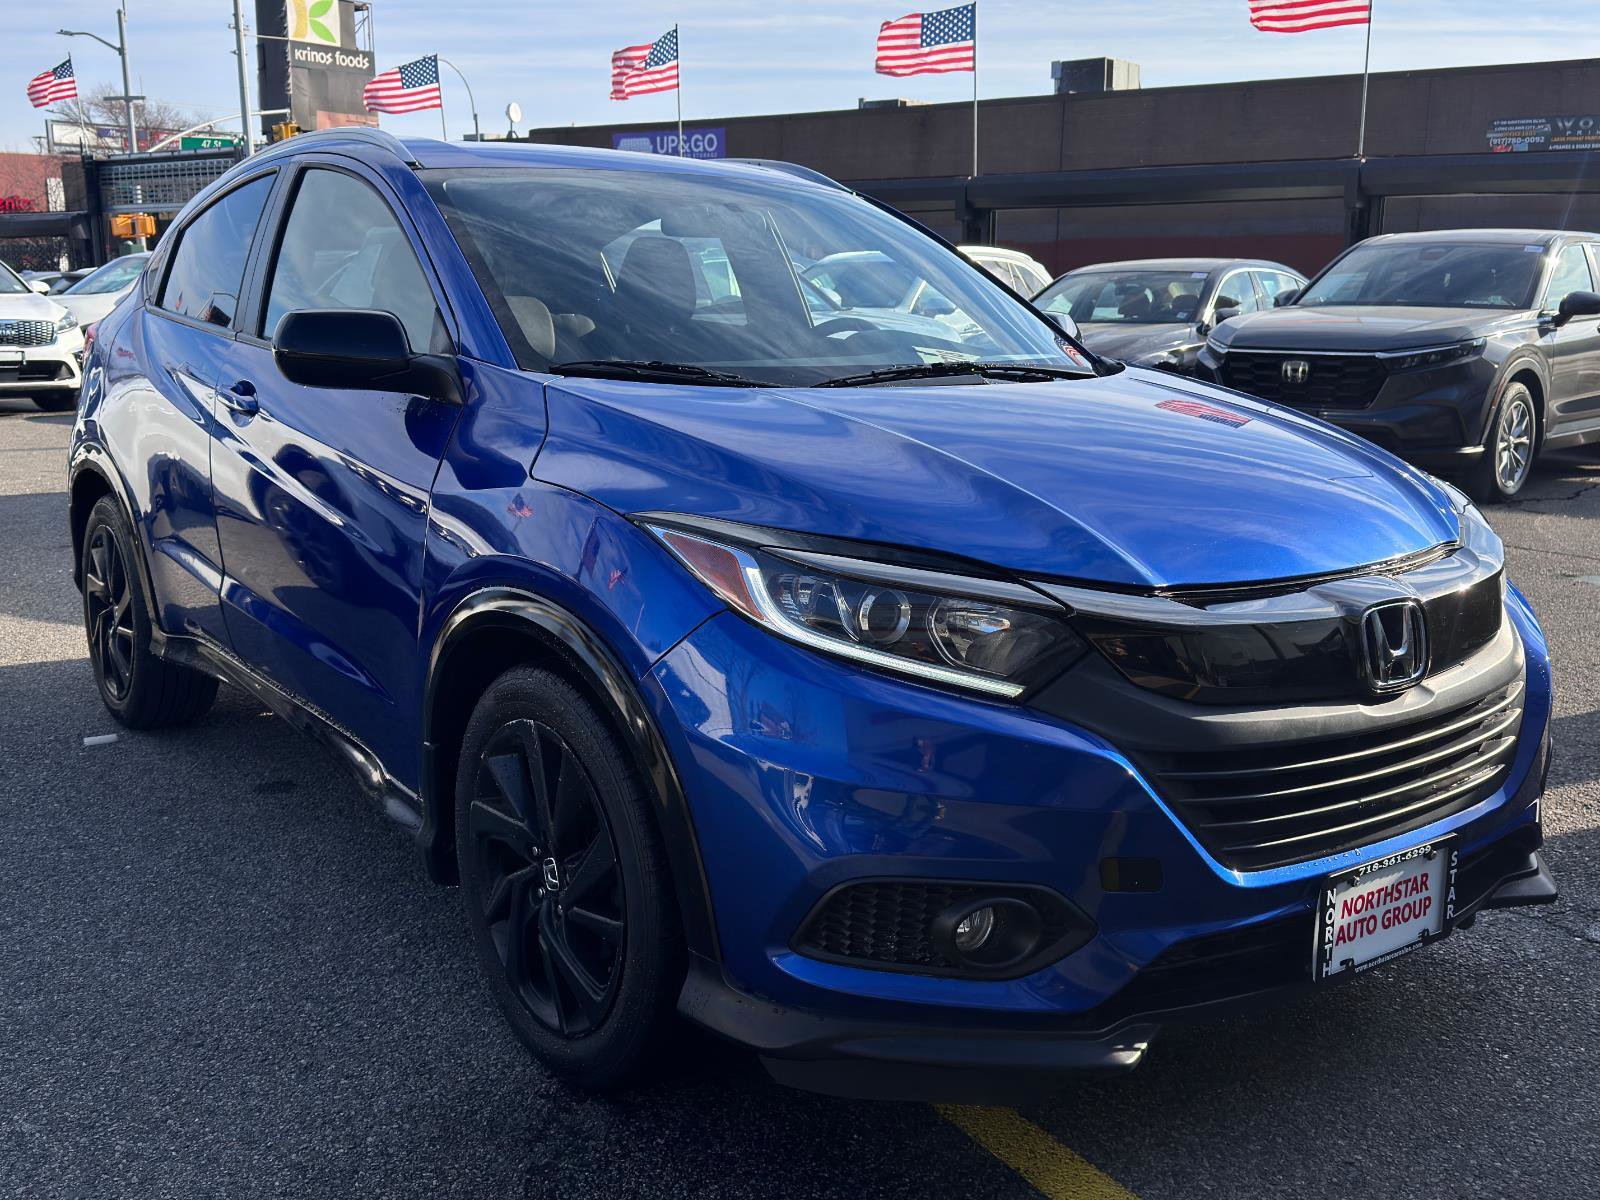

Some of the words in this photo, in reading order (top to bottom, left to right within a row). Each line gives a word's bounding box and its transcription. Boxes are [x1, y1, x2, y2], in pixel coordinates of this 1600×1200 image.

[335, 51, 370, 70] foods
[201, 139, 211, 149] 47
[213, 139, 222, 148] St
[656, 133, 718, 154] UP&GO
[1359, 845, 1431, 876] 718-361-6299
[1341, 872, 1429, 919] NORTHSTAR
[1446, 850, 1458, 919] STAR
[1322, 888, 1337, 978] NORTH
[1335, 914, 1378, 946] AUTO
[1381, 896, 1432, 930] GROUP
